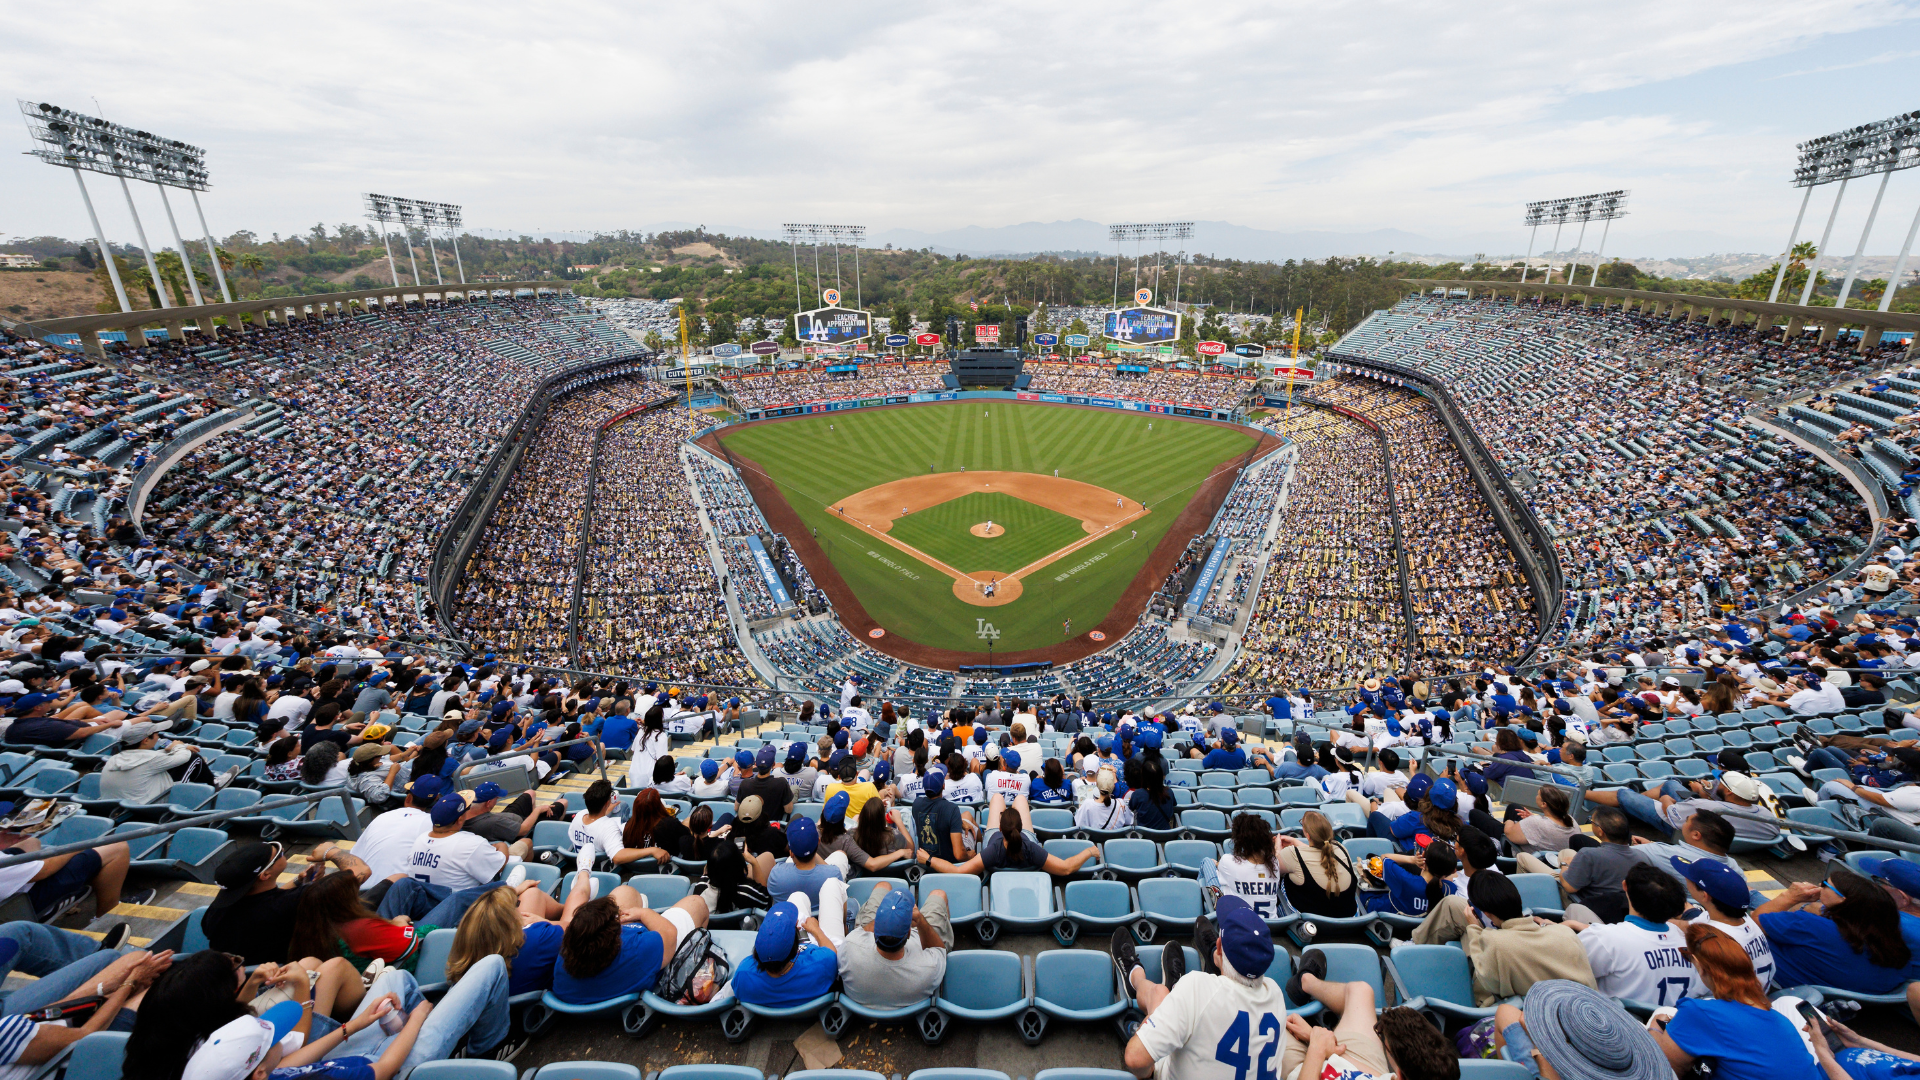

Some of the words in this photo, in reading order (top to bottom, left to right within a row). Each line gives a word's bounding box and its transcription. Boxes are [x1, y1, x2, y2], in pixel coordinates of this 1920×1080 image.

[807, 312, 828, 340] LA
[1114, 311, 1133, 339] LA
[1132, 320, 1173, 328] APPRECIATION
[1200, 344, 1223, 352] Coca-Cola
[668, 369, 702, 378] CUTWATER
[899, 568, 920, 580] FIELD
[975, 618, 1000, 639] LA
[1081, 713, 1090, 727] LA
[1303, 709, 1314, 718] 13
[997, 779, 1022, 791] OHTANI
[950, 789, 968, 798] BETTS
[575, 830, 594, 844] BETTS
[412, 849, 441, 869] URÍAS
[1235, 881, 1278, 895] FREEMA
[1253, 901, 1270, 918] 5
[1644, 947, 1692, 970] OHTAN
[1657, 977, 1690, 1005] 17
[1215, 1010, 1280, 1080] 42
